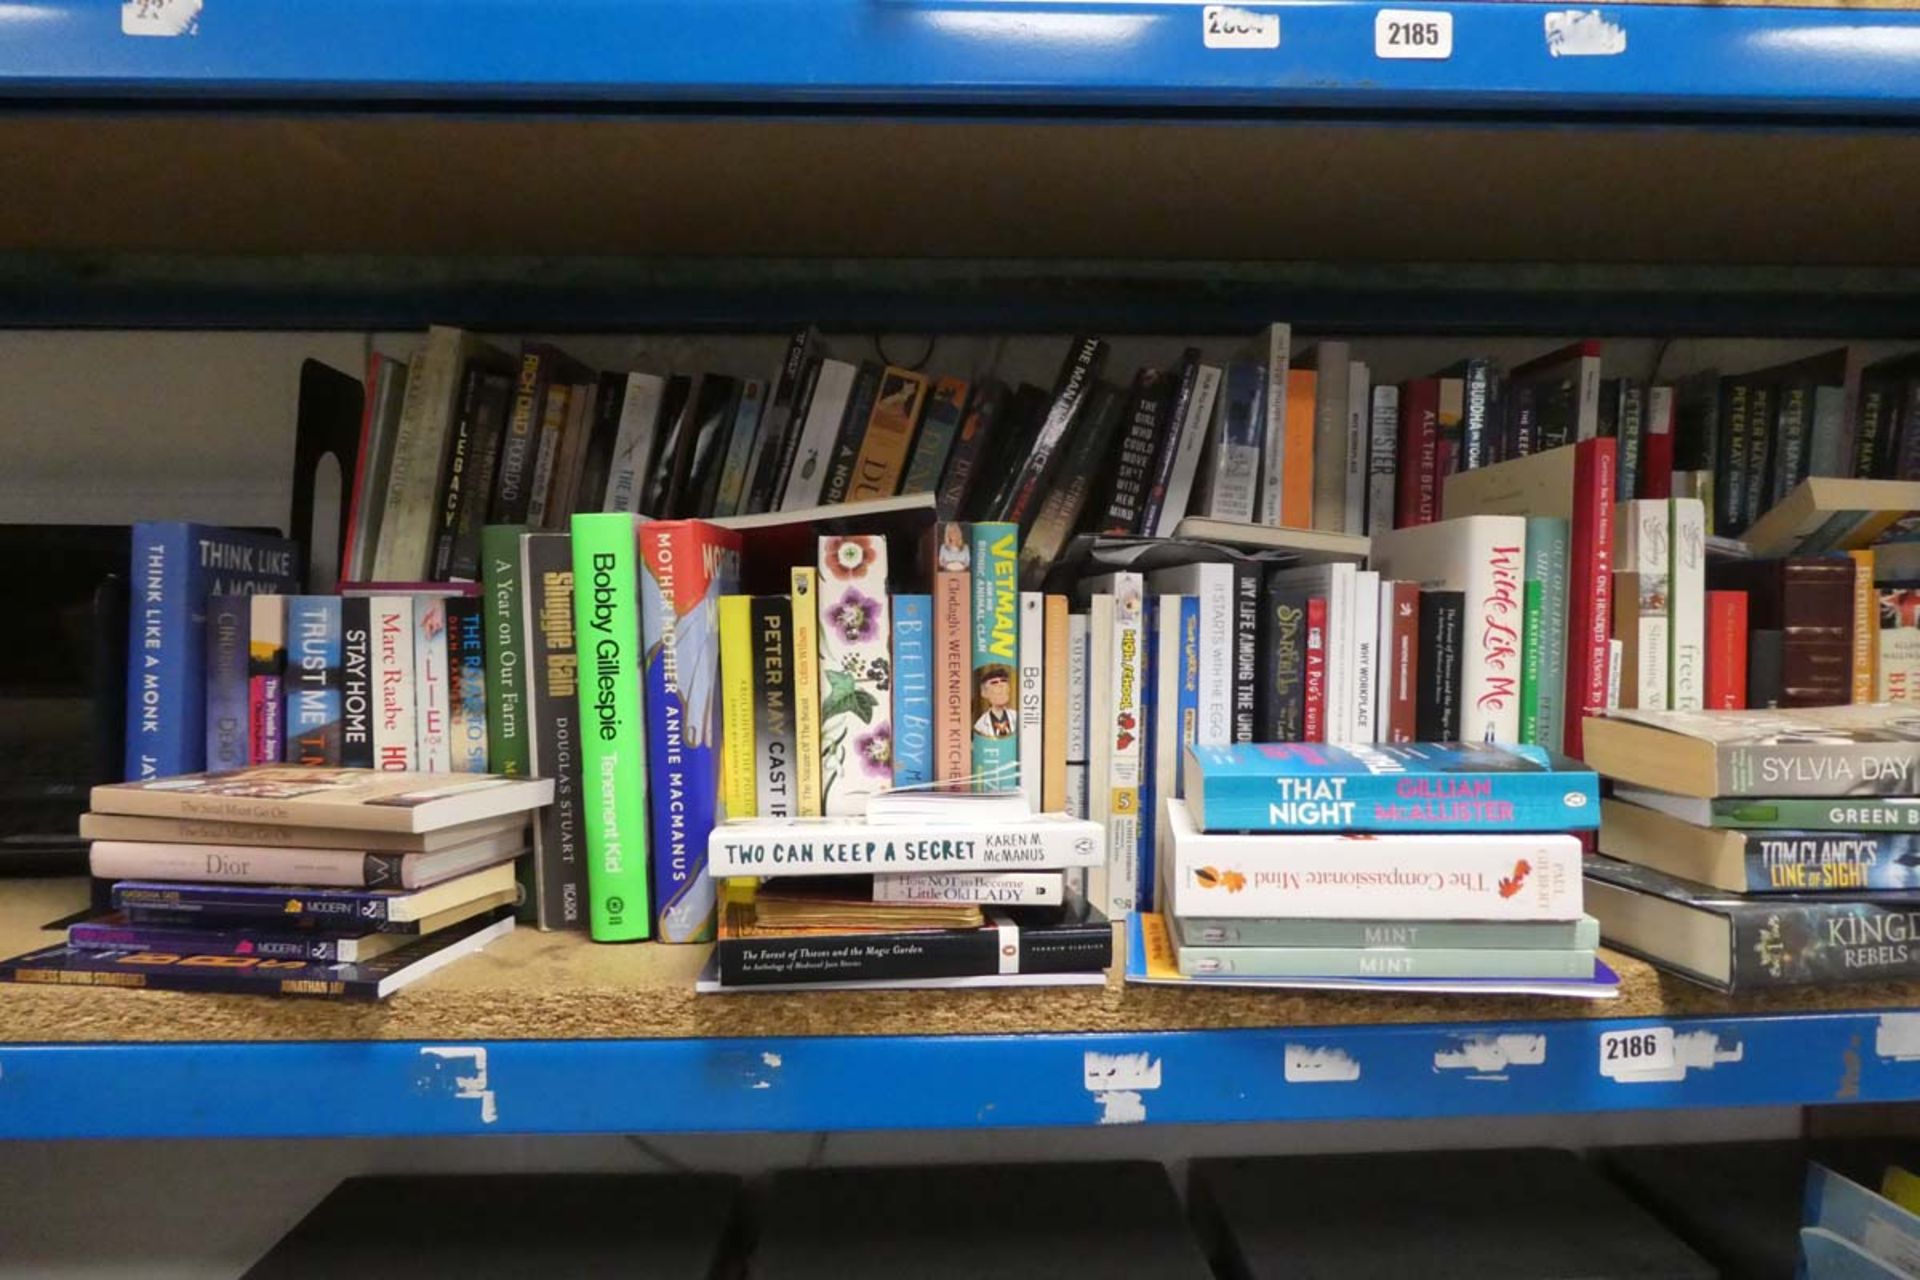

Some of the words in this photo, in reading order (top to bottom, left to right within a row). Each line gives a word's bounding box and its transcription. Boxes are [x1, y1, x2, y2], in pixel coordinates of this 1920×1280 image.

[1387, 23, 1439, 46] 2185
[1078, 338, 1100, 365] THE
[521, 353, 540, 393] RICH
[1063, 365, 1087, 404] MAN
[513, 394, 533, 436] DAD
[1469, 381, 1486, 430] BUDDHA
[1626, 388, 1640, 442] PETER
[1731, 385, 1747, 433] PETER
[1752, 389, 1767, 438] PETER
[1787, 388, 1803, 435] PETER
[1864, 392, 1881, 438] PETER
[1422, 410, 1435, 437] ALL
[1121, 452, 1149, 467] MOVE
[1123, 438, 1154, 452] COULD
[1420, 442, 1434, 472] THE
[1625, 443, 1639, 470] MAY
[1729, 435, 1745, 467] MAY
[1750, 440, 1765, 473] MAY
[1785, 440, 1800, 471] MAY
[1861, 441, 1877, 473] MAY
[1116, 479, 1140, 493] WITH
[1419, 475, 1433, 523] BEAUT
[1109, 505, 1135, 521] MIND
[199, 540, 254, 573] THINK
[258, 553, 291, 577] LIKE
[495, 559, 512, 573] A
[976, 540, 987, 577] BIONIC
[1554, 539, 1565, 567] OUT
[146, 544, 166, 602] THINK
[657, 532, 675, 611] MOTHER
[1240, 576, 1257, 598] MY
[1483, 546, 1521, 614] Wilde
[1596, 575, 1608, 594] ONE
[496, 579, 513, 617] Year
[539, 571, 574, 649] Shuggie
[590, 552, 618, 634] Bobby
[946, 577, 962, 636] Clodagh's
[976, 578, 987, 623] ANIMAL
[989, 534, 1018, 659] VETMAN
[144, 609, 163, 649] LIKE
[463, 614, 480, 649] THE
[1211, 593, 1225, 646] STARTS
[1239, 601, 1257, 630] LIFE
[1528, 609, 1539, 646] EARTH
[1595, 598, 1607, 642] HUNDRED
[1856, 566, 1871, 667] Bernardine
[301, 610, 328, 686] TRUST
[381, 613, 402, 665] Marc
[498, 624, 512, 644] on
[764, 615, 783, 684] PETER
[976, 624, 987, 653] CLAN
[1483, 615, 1518, 670] Like
[143, 655, 160, 668] A
[346, 630, 367, 681] STAY
[499, 650, 517, 687] Our
[660, 615, 678, 694] MOTHER
[1072, 637, 1083, 685] SUSAN
[1211, 648, 1225, 677] WITH
[1237, 631, 1256, 681] AMONG
[1309, 655, 1322, 665] A
[1359, 642, 1369, 666] WHY
[1527, 648, 1538, 681] LINES
[1592, 646, 1605, 688] REASONS
[1679, 644, 1700, 691] free
[265, 680, 278, 698] The
[547, 653, 578, 697] Bain
[594, 639, 622, 741] Gillespie
[948, 639, 962, 722] WEEKNIGHT
[1023, 667, 1040, 689] Be
[1210, 678, 1224, 698] THE
[1307, 670, 1323, 702] PUG'S
[141, 674, 160, 732] MONK
[301, 690, 328, 725] ME
[383, 670, 404, 731] Raabe
[1023, 694, 1040, 729] Still.
[1237, 683, 1255, 710] THE
[1357, 667, 1369, 727] WORKPLACE
[1476, 677, 1516, 711] Me
[1591, 689, 1602, 703] TO
[265, 701, 278, 736] Private
[345, 682, 367, 743] HOME
[466, 714, 482, 740] TO
[501, 692, 518, 739] Farm
[767, 690, 785, 736] MAY
[1071, 692, 1083, 753] SONTAG
[1209, 702, 1224, 739] EGG
[1306, 707, 1318, 736] GUIDE
[1526, 716, 1537, 736] PAT
[218, 717, 237, 762] DEAD
[665, 706, 682, 765] ANNIE
[901, 714, 931, 764] BOY
[555, 717, 572, 795] DOUGLAS
[768, 741, 787, 797] CAST
[948, 728, 962, 792] KITCHEN
[1762, 756, 1854, 782] SYLVIA
[1861, 756, 1912, 781] DAY
[600, 752, 623, 840] Tenement
[1276, 778, 1348, 801] THAT
[1395, 778, 1492, 798] GILLIAN
[669, 773, 687, 882] MACMANUS
[1268, 803, 1356, 826] NIGHT
[1374, 801, 1515, 823] McALLISTER
[1828, 808, 1899, 824] GREEN
[1908, 809, 1920, 824] B
[560, 801, 576, 863] STUART
[985, 833, 1027, 848] KAREN
[205, 854, 251, 875] Dior
[604, 841, 623, 873] Kid
[725, 843, 765, 865] TWO
[772, 843, 814, 863] CAN
[823, 842, 877, 863] KEEP
[884, 841, 896, 862] A
[905, 839, 976, 861] SECRET
[983, 848, 1046, 864] McMANUS
[1760, 841, 1798, 868] TOM
[1800, 841, 1878, 866] CLANCY'S
[900, 875, 927, 887] How
[928, 874, 957, 887] NOT
[974, 876, 1025, 889] Become
[1254, 868, 1301, 890] Mind
[1306, 866, 1445, 891] Compassionate
[1448, 871, 1490, 892] The
[1771, 863, 1806, 888] LINE
[1823, 863, 1870, 888] SIGHT
[307, 900, 351, 913] MODERN
[562, 882, 578, 923] PICADOR
[907, 887, 943, 900] Little
[943, 886, 971, 901] Old
[974, 888, 1025, 902] LADY
[257, 942, 302, 954] MODERN
[742, 950, 758, 961] The
[760, 949, 786, 960] Forest
[787, 948, 797, 961] of
[800, 947, 830, 958] Thieves
[832, 948, 848, 957] and
[850, 946, 863, 957] the
[865, 945, 890, 958] Magic
[892, 944, 923, 955] Garden
[1364, 927, 1420, 944] MINT
[754, 961, 785, 972] Anthology
[1359, 957, 1416, 973] MINT
[1844, 944, 1909, 969] REBELS
[1606, 1034, 1658, 1061] 2186
